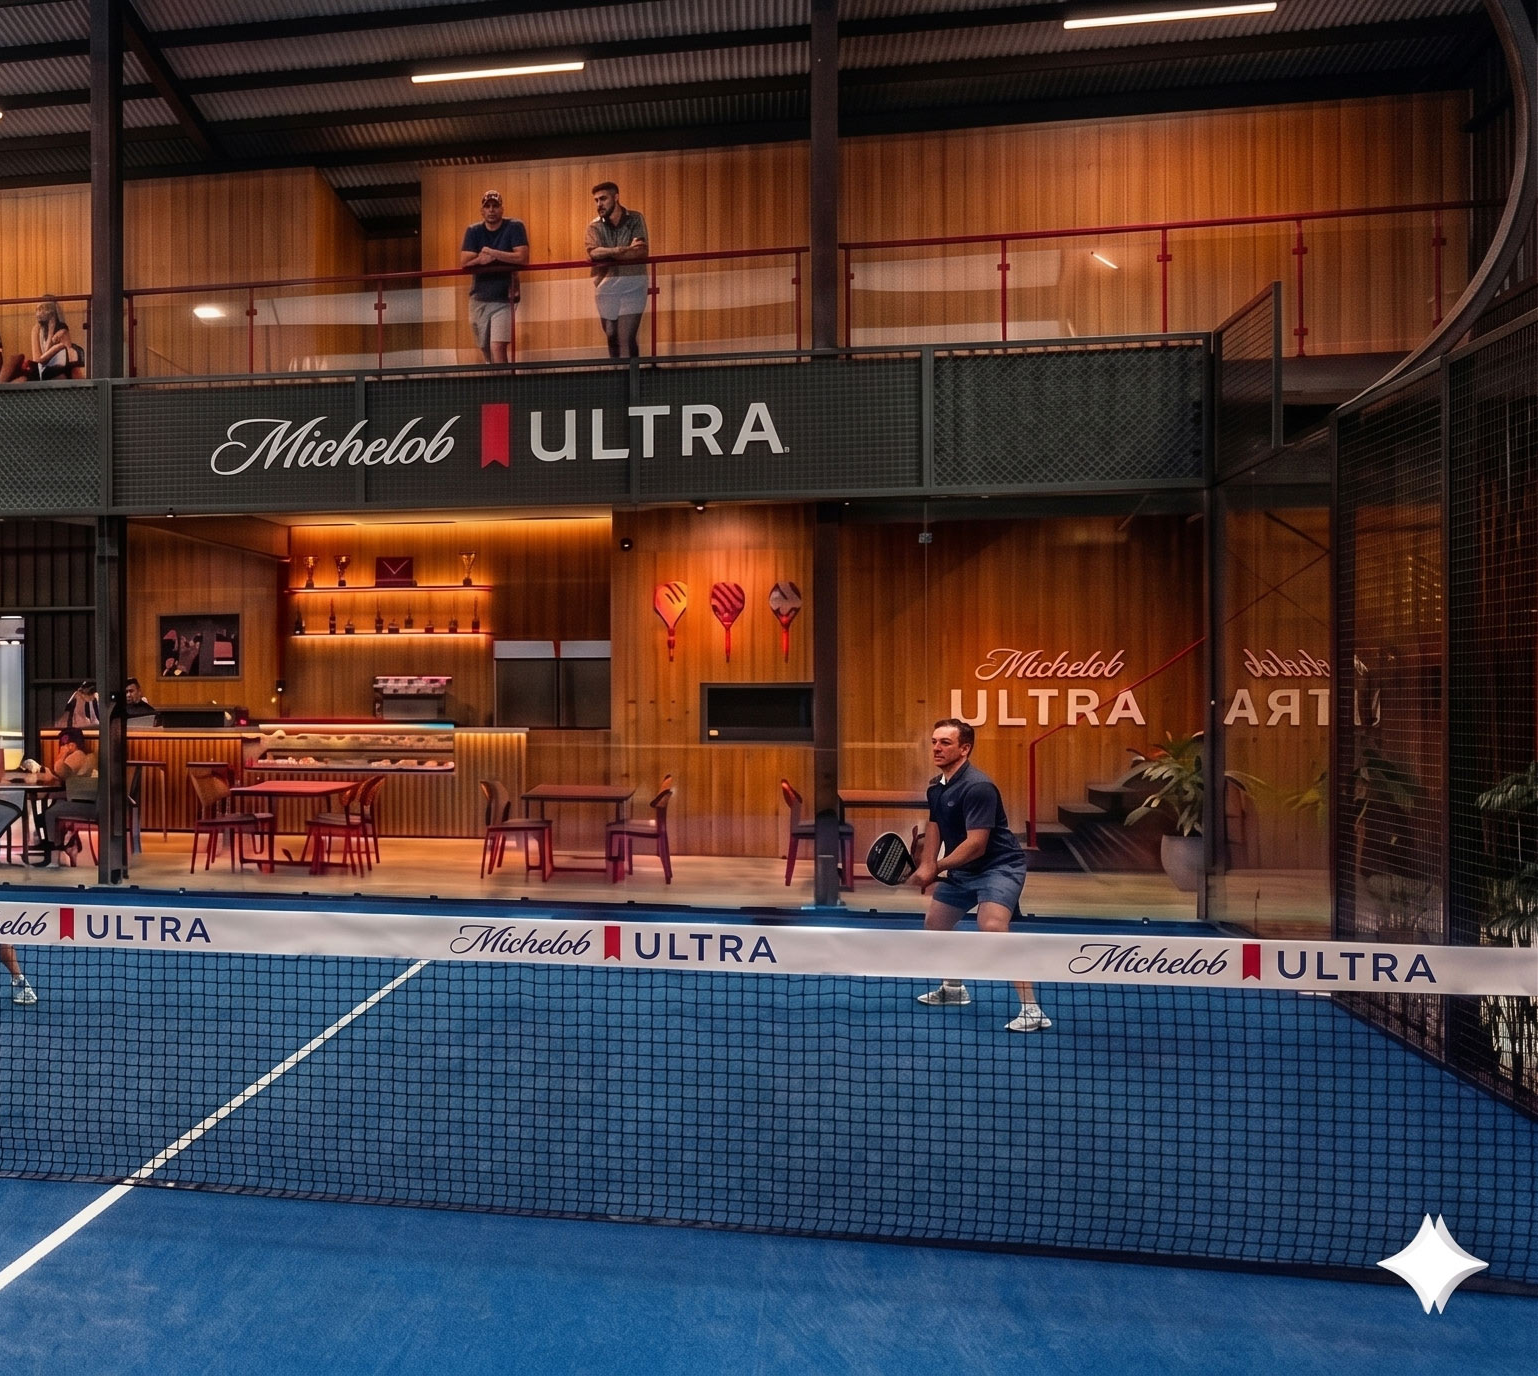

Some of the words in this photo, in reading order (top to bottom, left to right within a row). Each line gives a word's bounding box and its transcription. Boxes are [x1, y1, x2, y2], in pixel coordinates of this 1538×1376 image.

[211, 415, 461, 476] Michelob
[529, 402, 785, 462] ULTRA
[975, 649, 1125, 681] Michelob
[949, 689, 1147, 727] ULTRA
[87, 915, 210, 943] ULTRA
[450, 925, 592, 955] Michelob
[635, 933, 776, 963] ULTRA
[1069, 944, 1229, 975] Michelob
[1278, 951, 1436, 983] ULTRA
